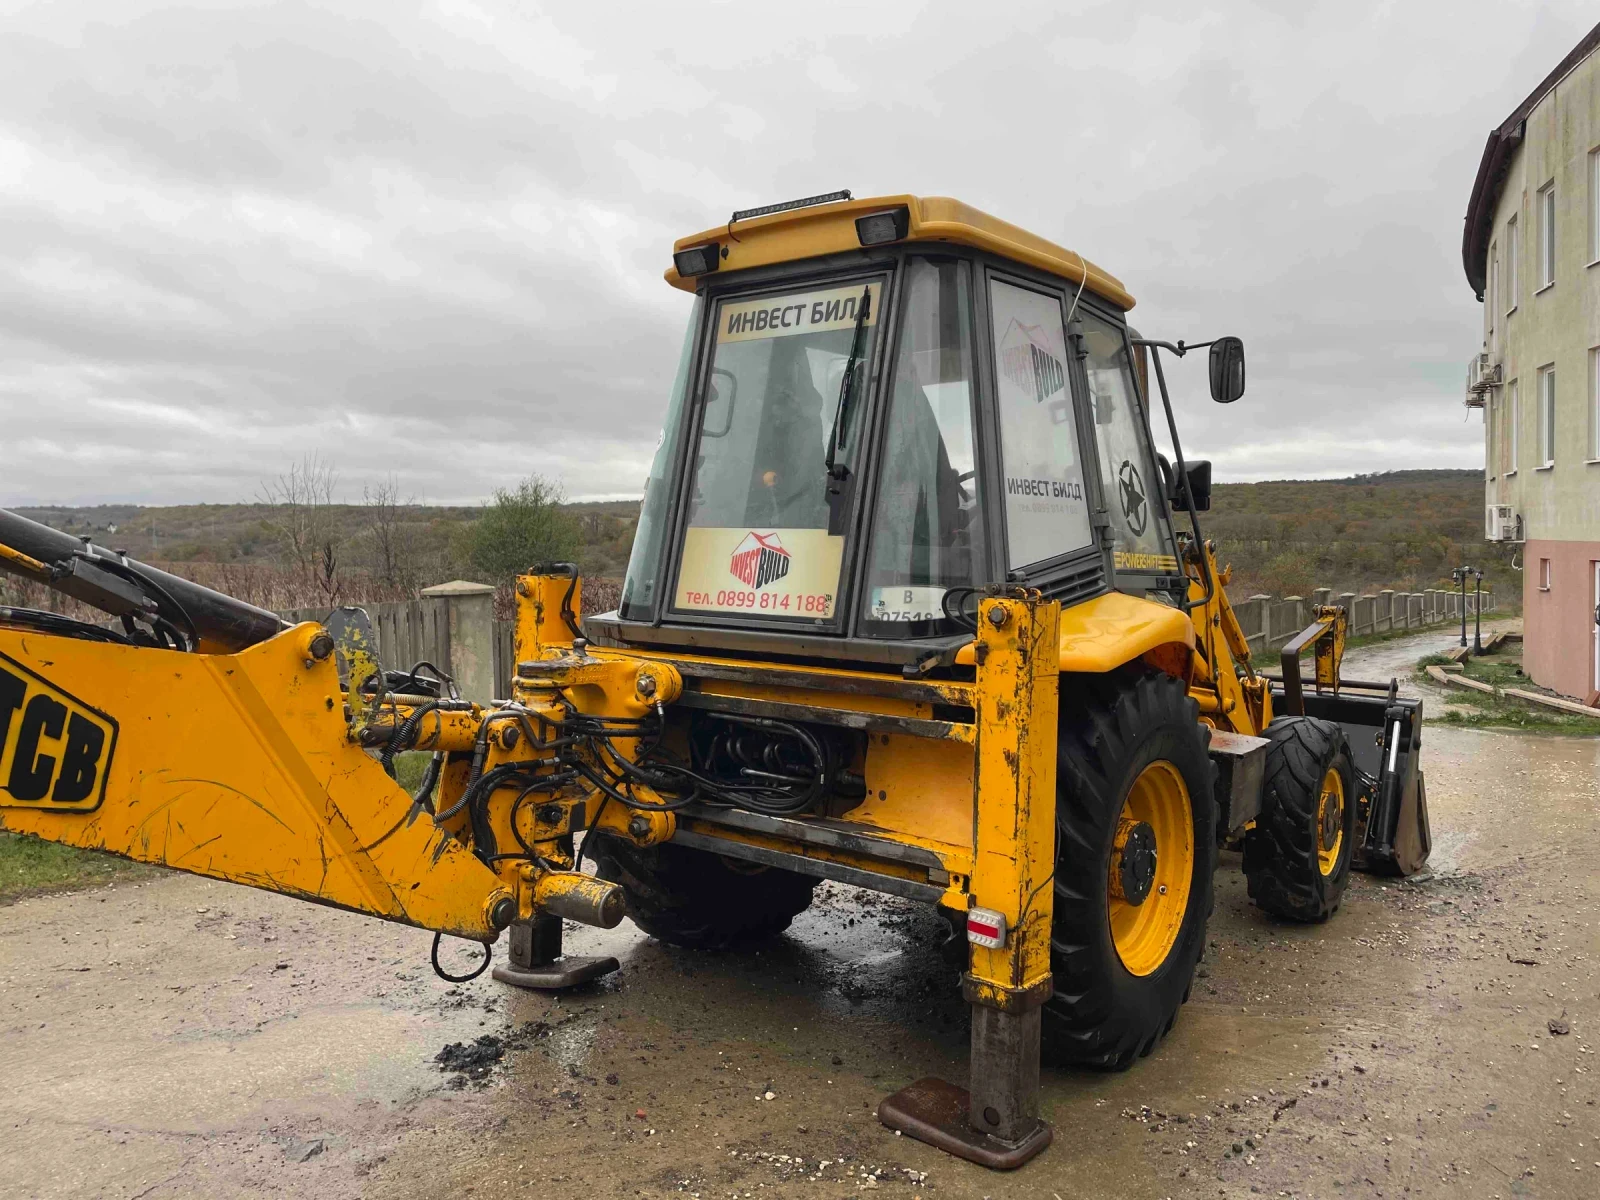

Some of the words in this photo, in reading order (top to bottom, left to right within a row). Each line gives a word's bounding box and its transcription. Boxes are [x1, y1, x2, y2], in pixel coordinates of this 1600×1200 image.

[727, 304, 807, 335] ИНВЕСТ
[1030, 343, 1065, 404] BUILD
[1007, 477, 1050, 497] ИНВЕСТ
[1051, 481, 1083, 501] БИЛД
[730, 547, 762, 590] INVEST
[755, 546, 790, 590] BUILD
[1120, 552, 1159, 569] POWERSHIFT
[686, 591, 713, 606] тел.
[716, 590, 756, 608] 0899
[759, 592, 790, 610] 814
[796, 594, 826, 613] 188
